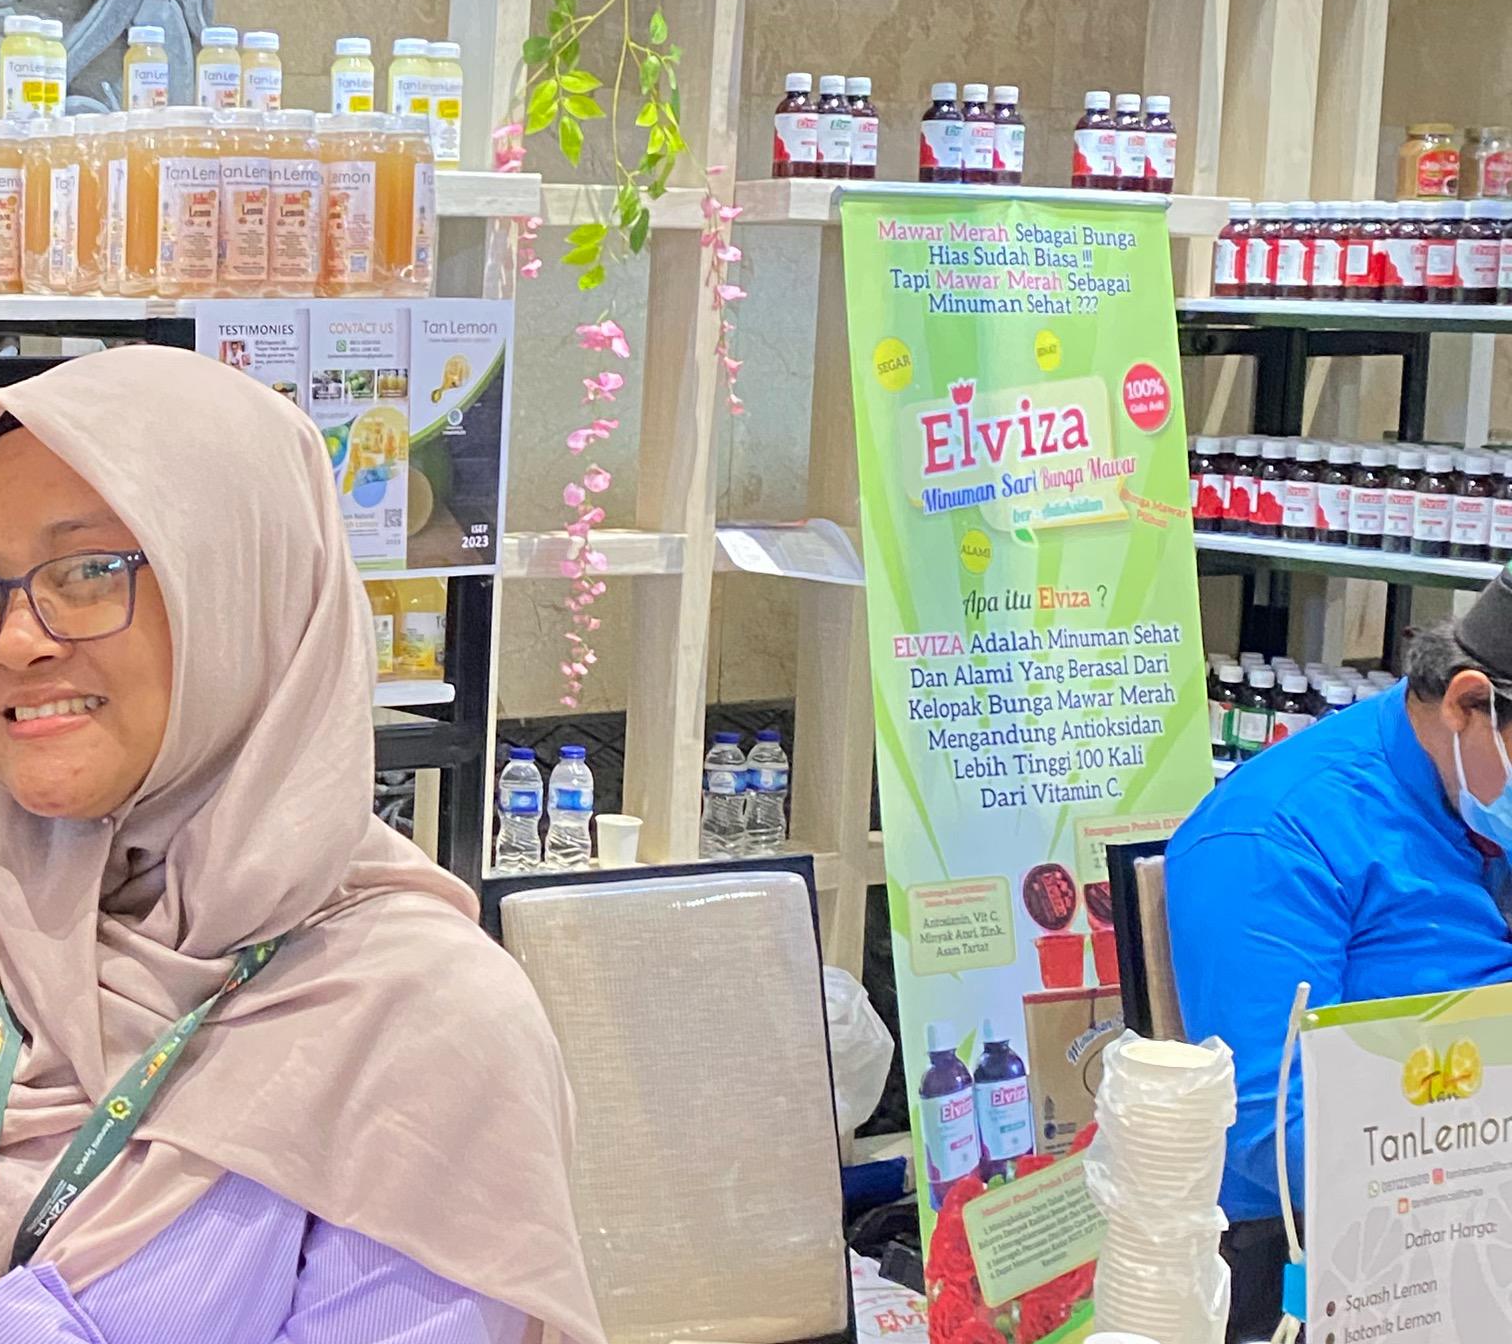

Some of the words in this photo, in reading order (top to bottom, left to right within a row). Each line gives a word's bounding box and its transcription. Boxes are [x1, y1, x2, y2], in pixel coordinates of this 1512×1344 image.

[331, 172, 371, 185] emon
[878, 220, 943, 242] Mawar
[950, 223, 1009, 243] Merah
[1015, 223, 1078, 249] Sebagai
[1082, 227, 1137, 249] Bunga
[929, 246, 970, 265] Hias
[974, 246, 1029, 267] Sudah
[1034, 247, 1078, 268] Biasa
[890, 268, 931, 293] Tapi
[936, 270, 1000, 290] Mawar
[1007, 270, 1063, 291] Merah
[1067, 273, 1131, 295] Sebagai
[929, 294, 1023, 314] Minuman
[1028, 294, 1072, 315] Sehat
[218, 324, 294, 336] TESTIMONIES
[329, 322, 376, 334] CONTACT
[379, 322, 394, 334] US
[1126, 378, 1165, 399] 100%
[921, 398, 1090, 477] Elviza
[921, 483, 996, 514] Minuman
[1002, 471, 1037, 500] Sari
[1041, 466, 1083, 492] Bunga
[1087, 457, 1137, 482] Mawar
[461, 535, 489, 548] 2023
[963, 589, 998, 620] Apa
[1005, 589, 1032, 611] itu
[1039, 587, 1091, 610] Elviza
[893, 634, 965, 658] ELVIZA
[970, 631, 1042, 655] Adalah
[1047, 627, 1129, 650] Minuman
[1134, 624, 1180, 646] Sehat
[910, 667, 948, 689] Dan
[954, 662, 1014, 687] Alami
[1019, 660, 1065, 684] Yang
[1069, 656, 1129, 678] Berasal
[1134, 653, 1169, 674] Dari
[908, 697, 983, 722] Kelopak
[988, 692, 1053, 716] Bunga
[1057, 689, 1114, 710] Mawar
[1120, 683, 1176, 705] Merah
[928, 725, 1057, 751] Mengandung
[1061, 715, 1163, 740] Antioksidan
[954, 756, 1007, 780] Lebih
[1013, 751, 1072, 777] Tinggi
[1075, 749, 1104, 771] 100
[1109, 745, 1144, 766] Kali
[981, 786, 1028, 808] Dari
[1032, 780, 1103, 804] Vitamin
[1405, 1225, 1445, 1250] Daftar
[1345, 1290, 1389, 1312] Squash
[1393, 1279, 1437, 1301] Lemon
[874, 1309, 926, 1332] Elvi
[1344, 1323, 1393, 1344] Isotonik
[1396, 1311, 1442, 1333] Lemon
